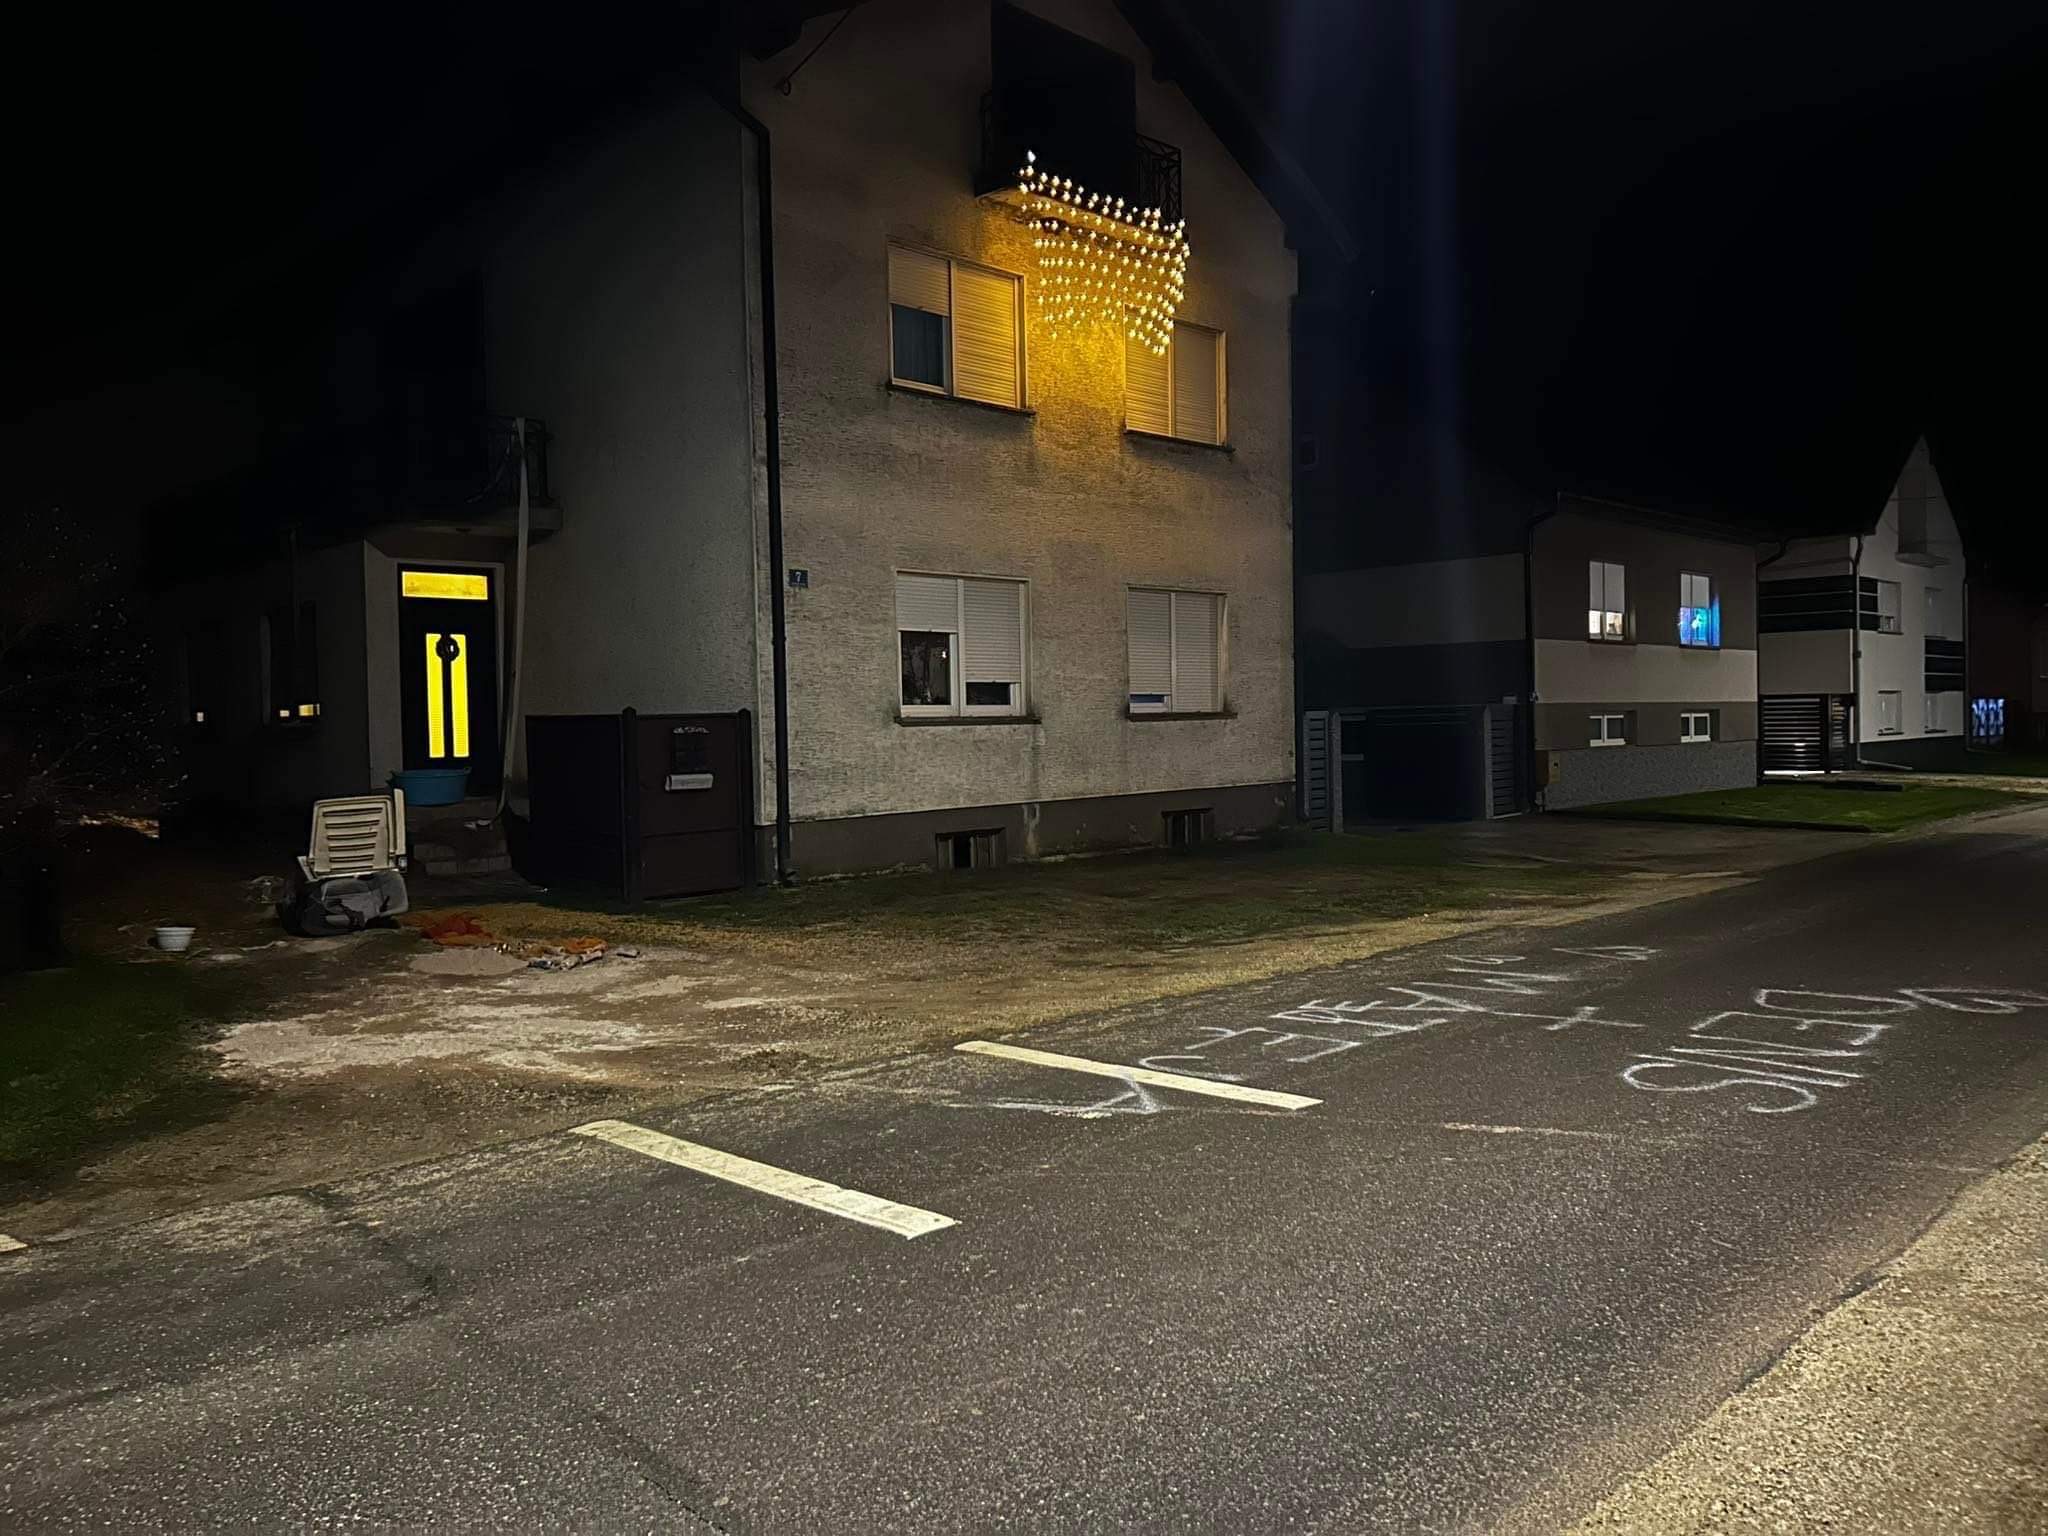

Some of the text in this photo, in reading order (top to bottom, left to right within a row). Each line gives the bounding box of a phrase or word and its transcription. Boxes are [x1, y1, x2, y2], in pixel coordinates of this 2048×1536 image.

[795, 571, 802, 583] 7
[985, 967, 1585, 1115] MATEJA
[1619, 988, 1918, 1112] DENIS
